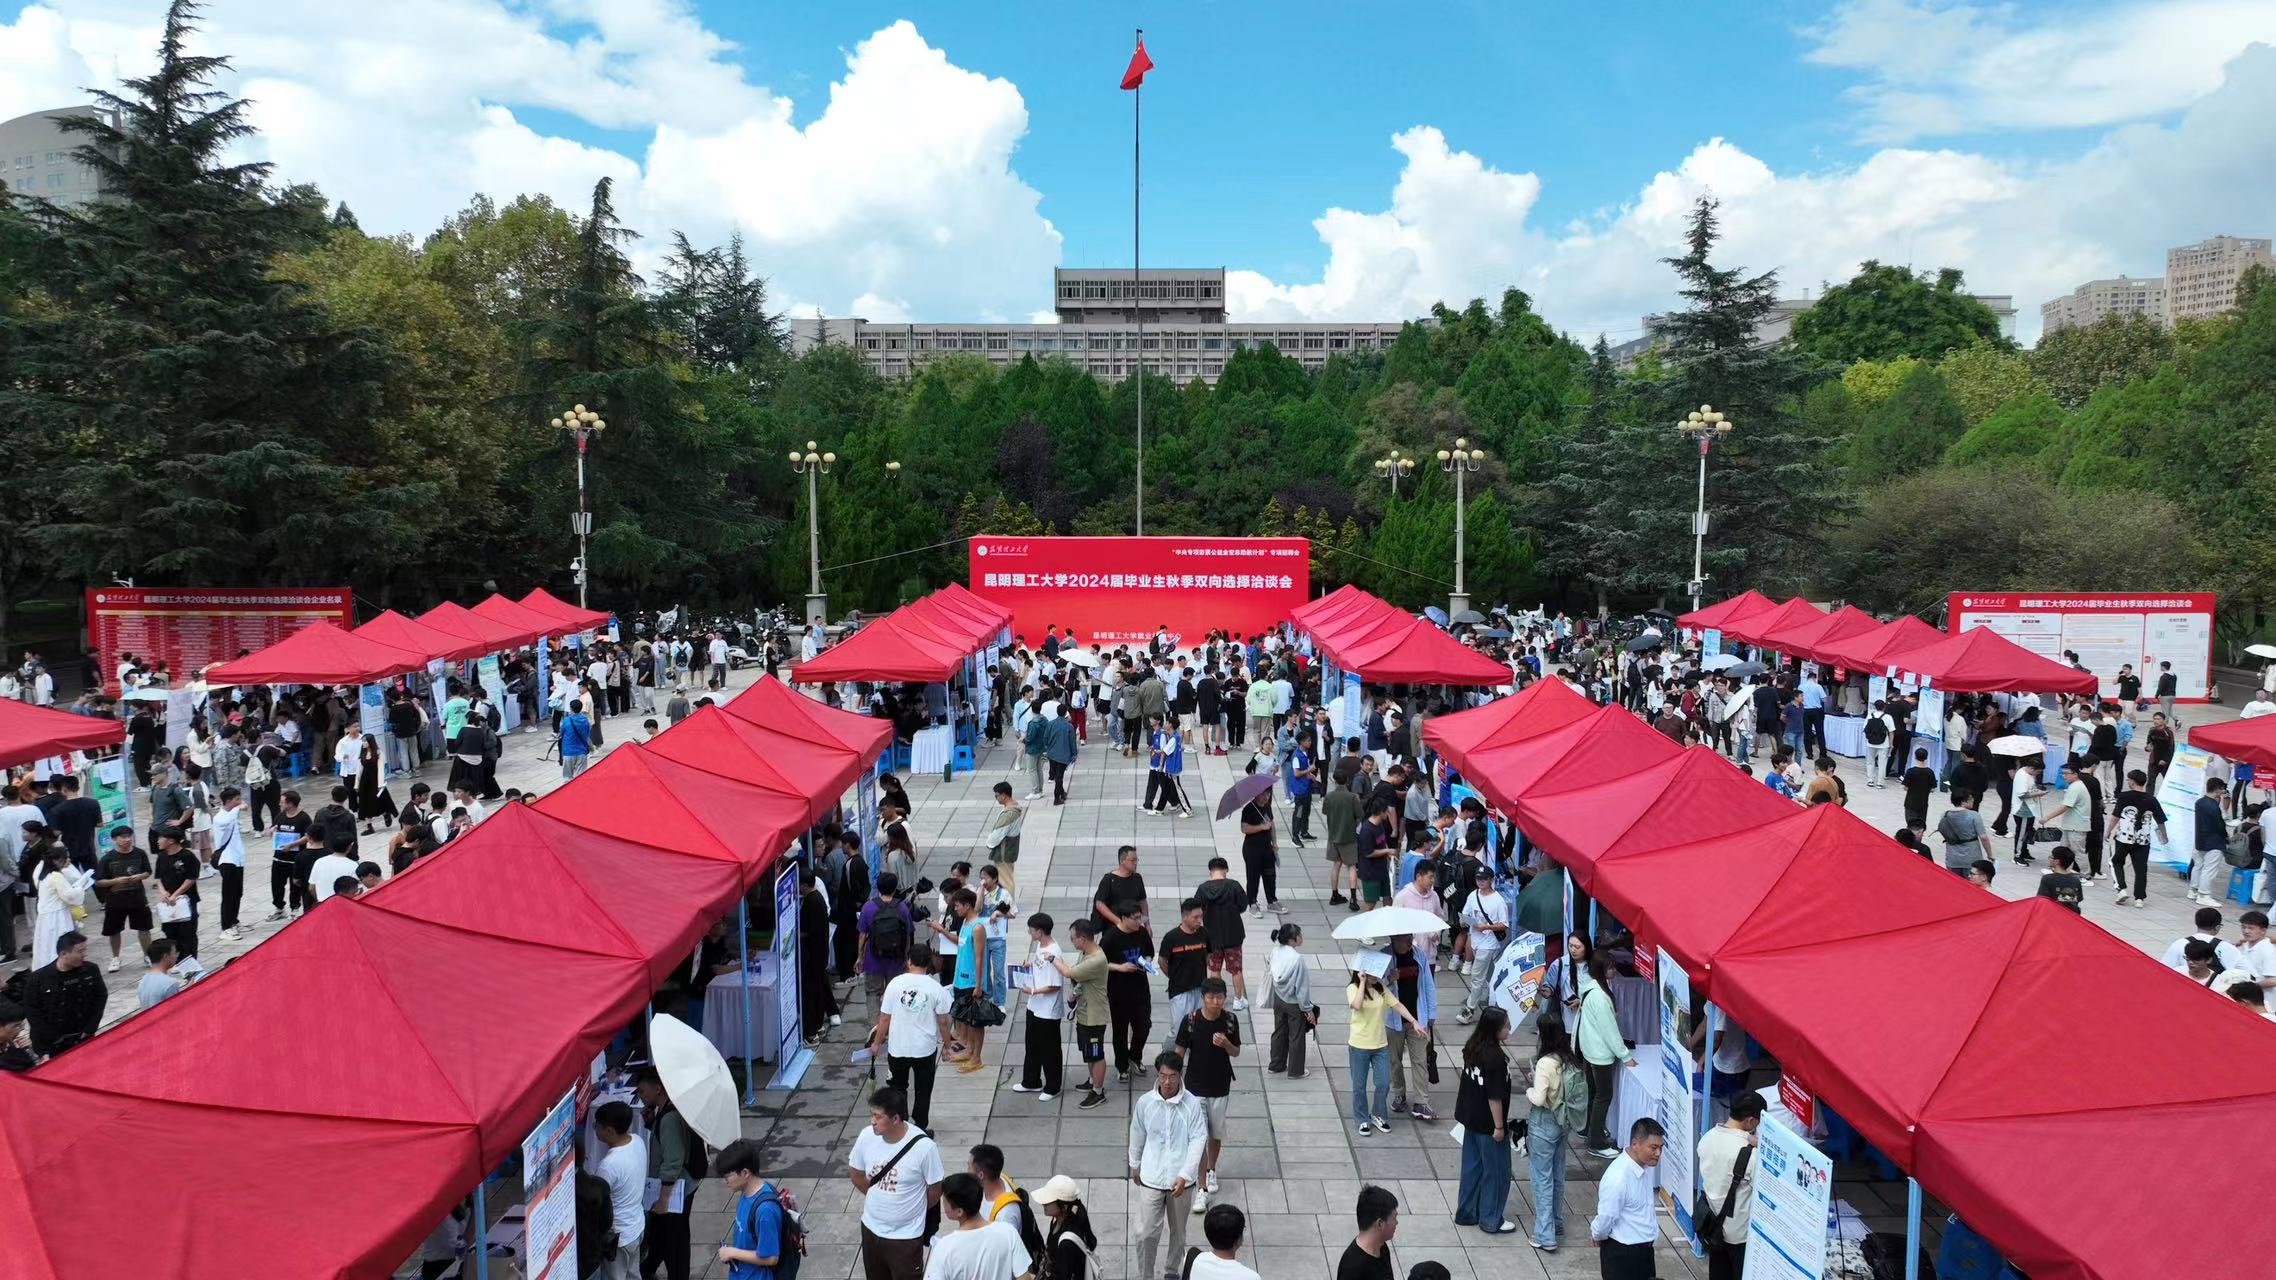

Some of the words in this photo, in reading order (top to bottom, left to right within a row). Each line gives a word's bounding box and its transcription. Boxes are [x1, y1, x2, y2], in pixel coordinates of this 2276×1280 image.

[984, 573, 1294, 589] 昆明理工大学2024届毕业生秋季双向选择洽谈会
